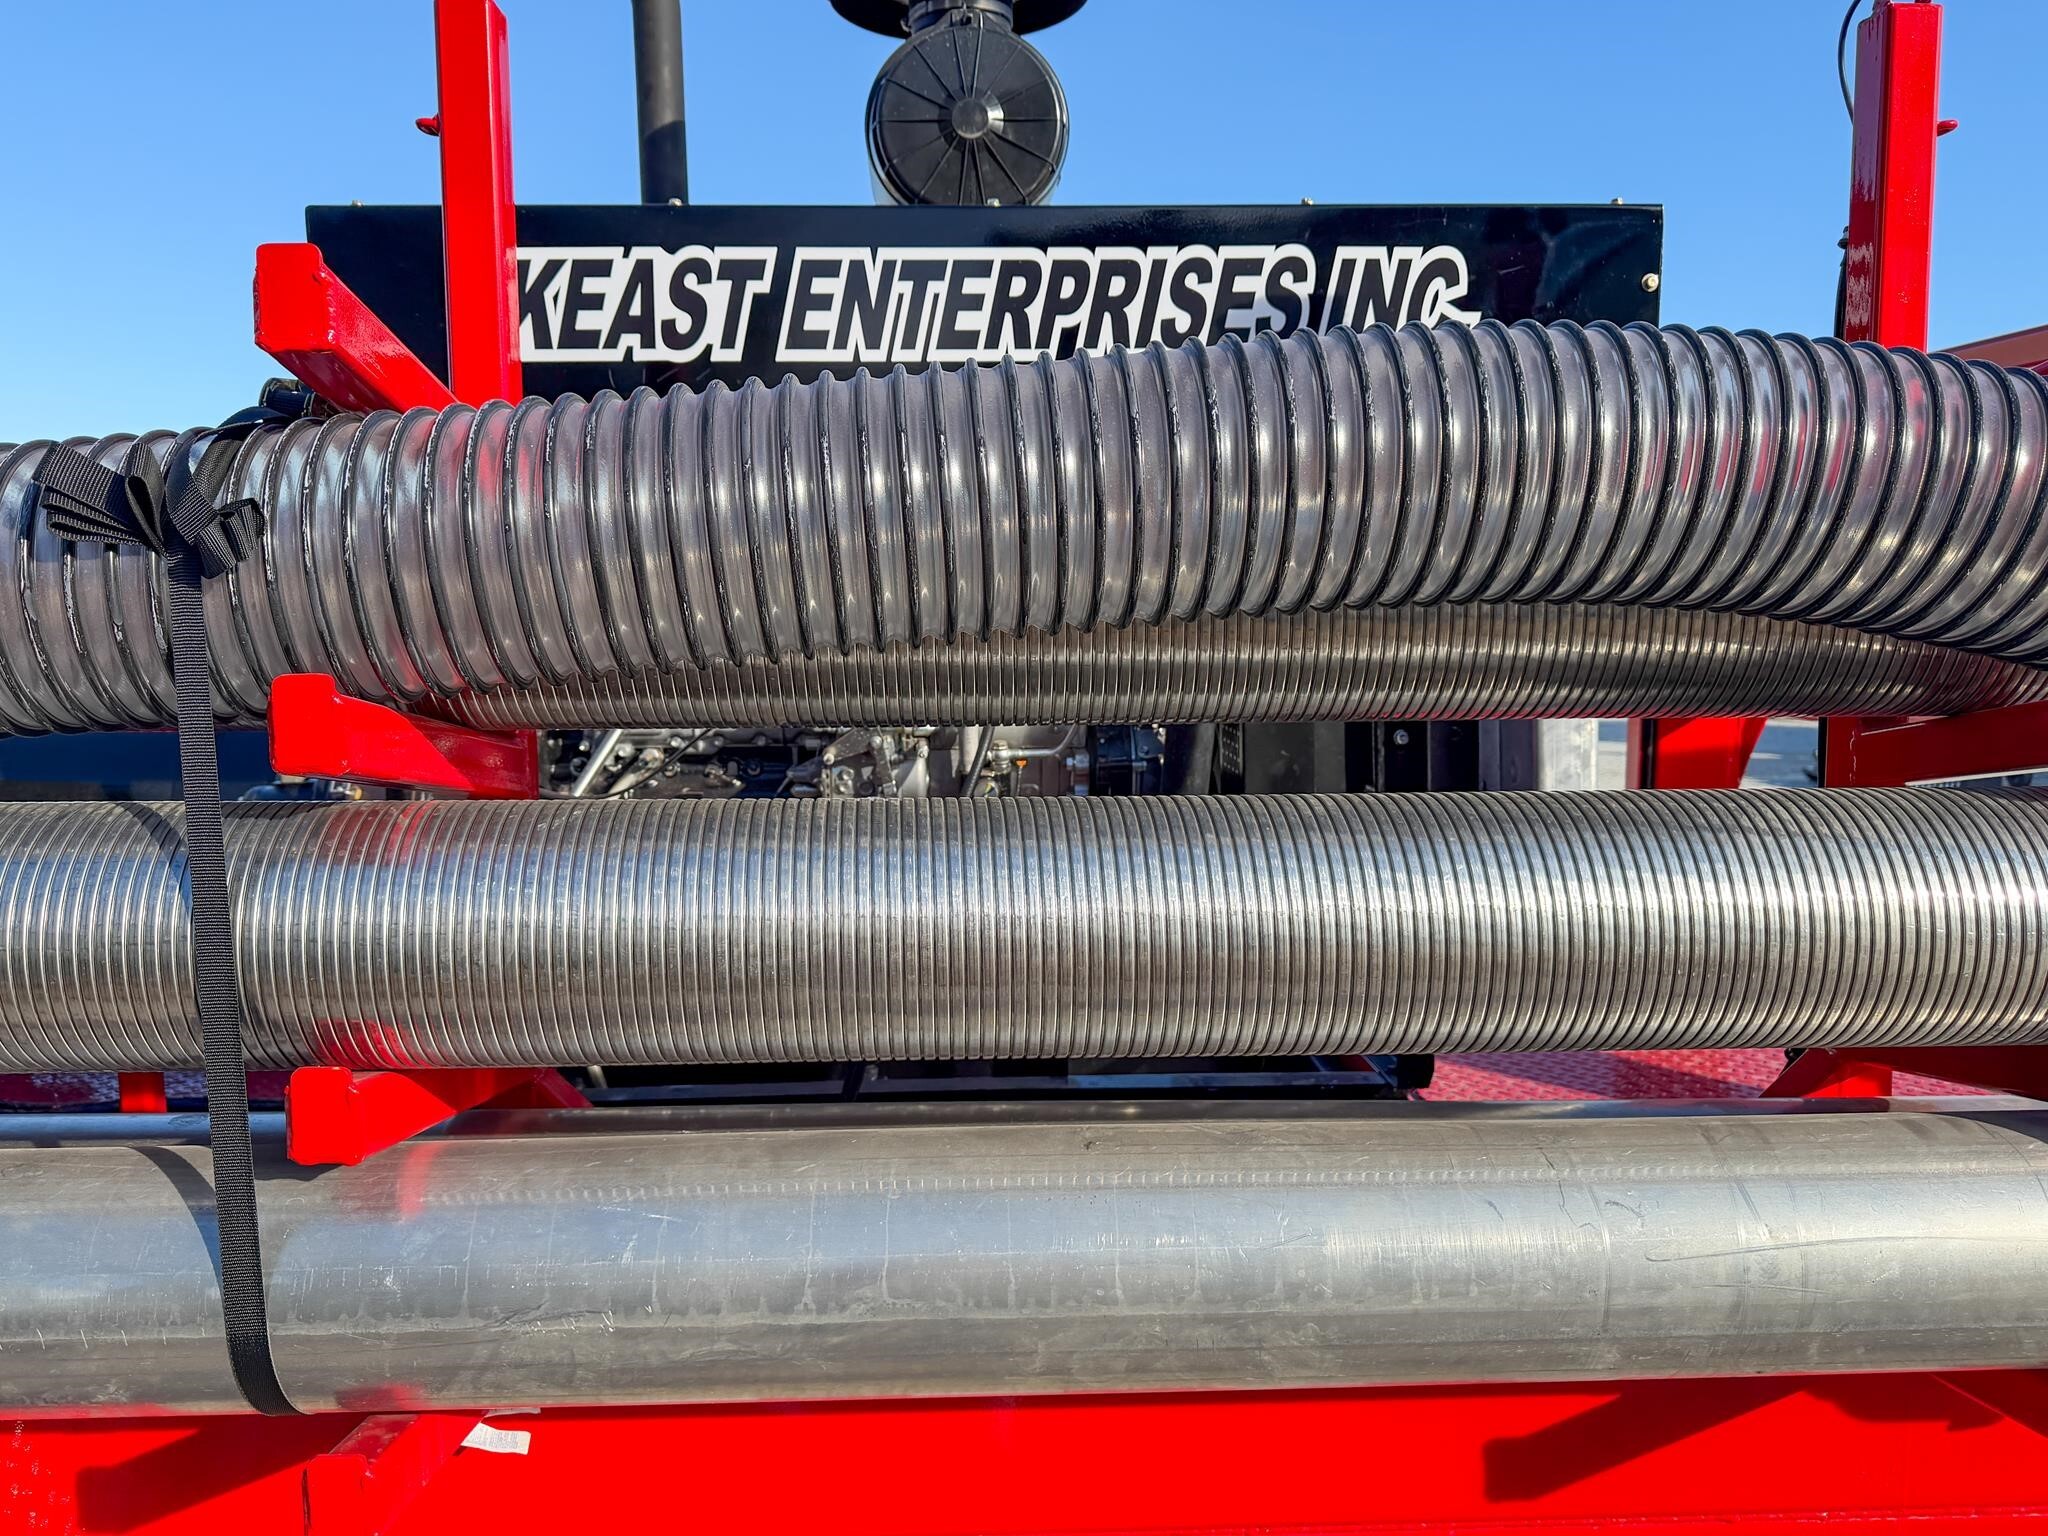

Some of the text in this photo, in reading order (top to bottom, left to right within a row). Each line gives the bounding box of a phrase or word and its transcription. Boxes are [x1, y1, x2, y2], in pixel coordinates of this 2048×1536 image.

[517, 244, 1482, 362] KEAST ENTERPRISES INC
